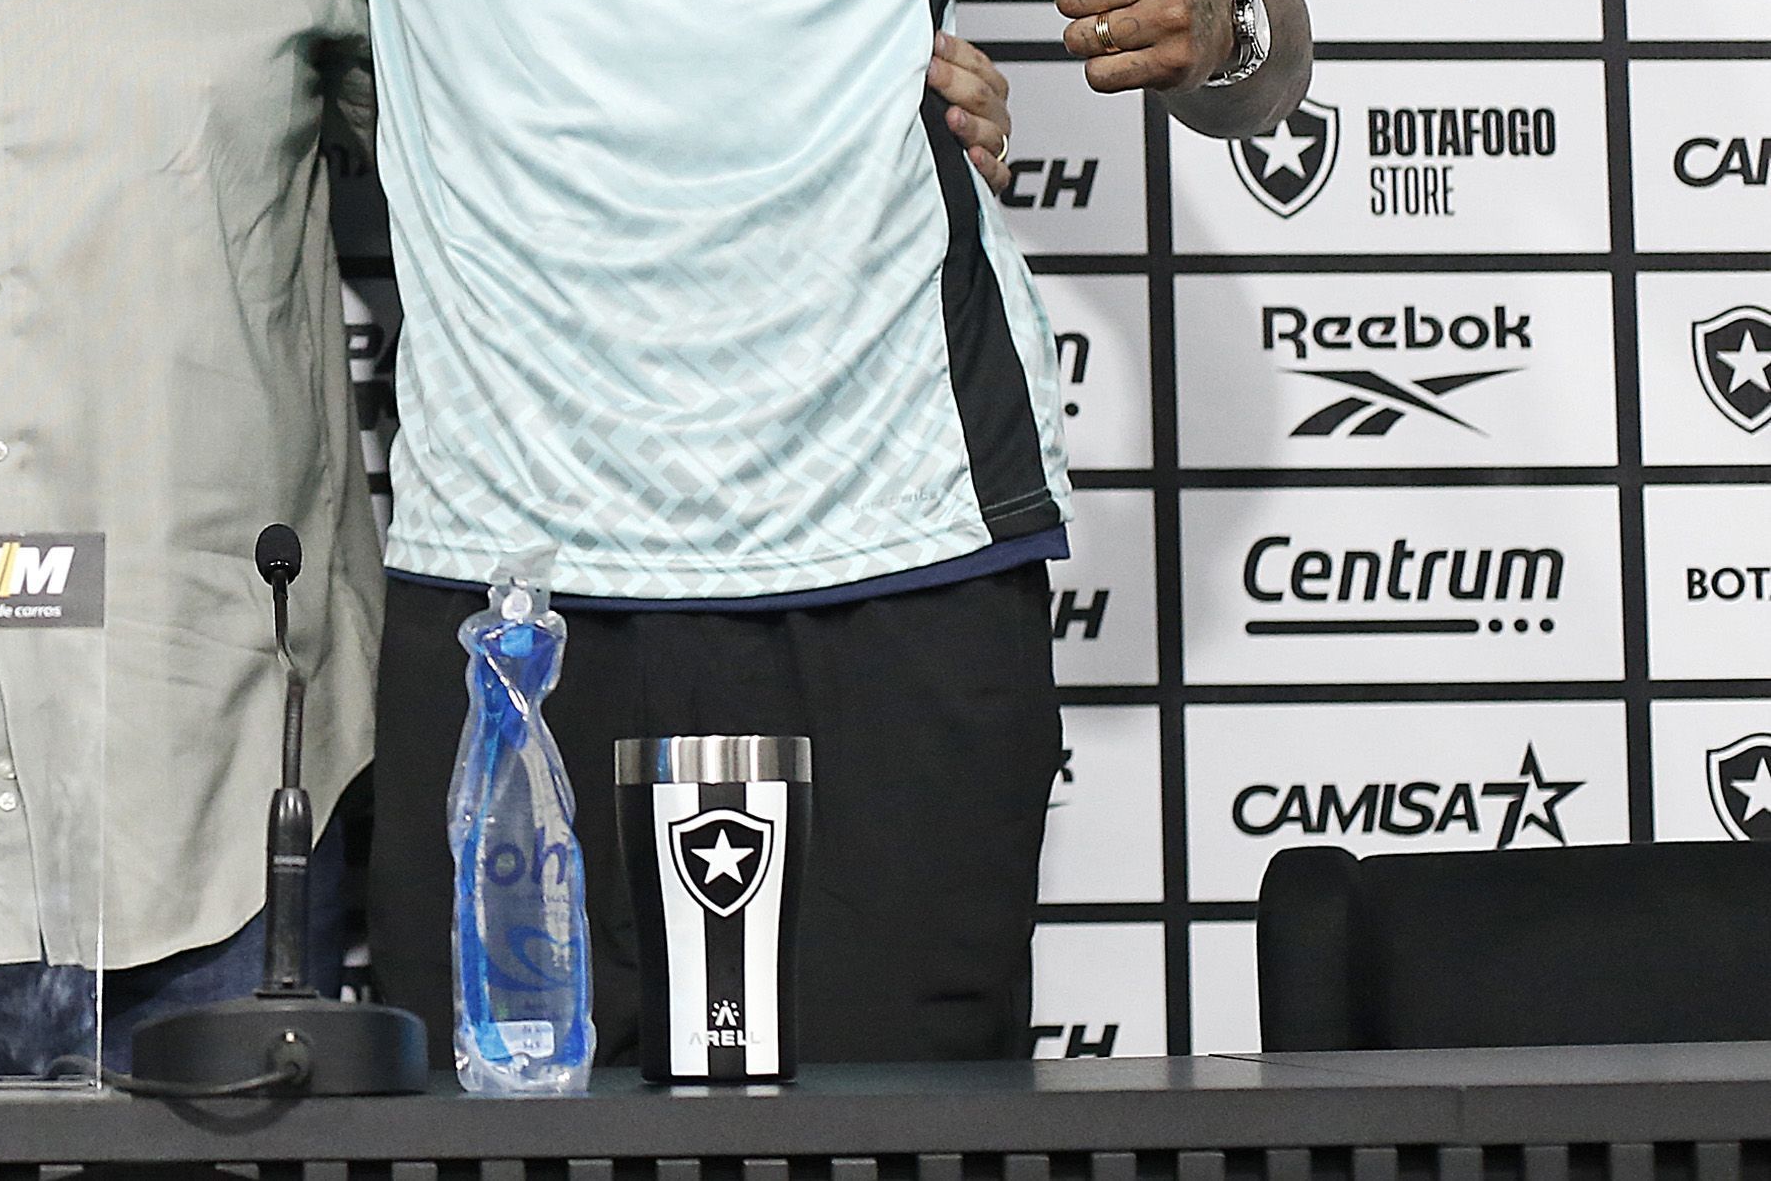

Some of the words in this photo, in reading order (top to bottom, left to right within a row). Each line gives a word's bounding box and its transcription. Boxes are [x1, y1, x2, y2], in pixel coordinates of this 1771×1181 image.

[1368, 107, 1556, 158] BOTAFOGO
[1370, 165, 1455, 217] STORE
[1262, 305, 1532, 360] Reebok
[1243, 535, 1564, 604] Centrum
[15, 607, 61, 618] carros
